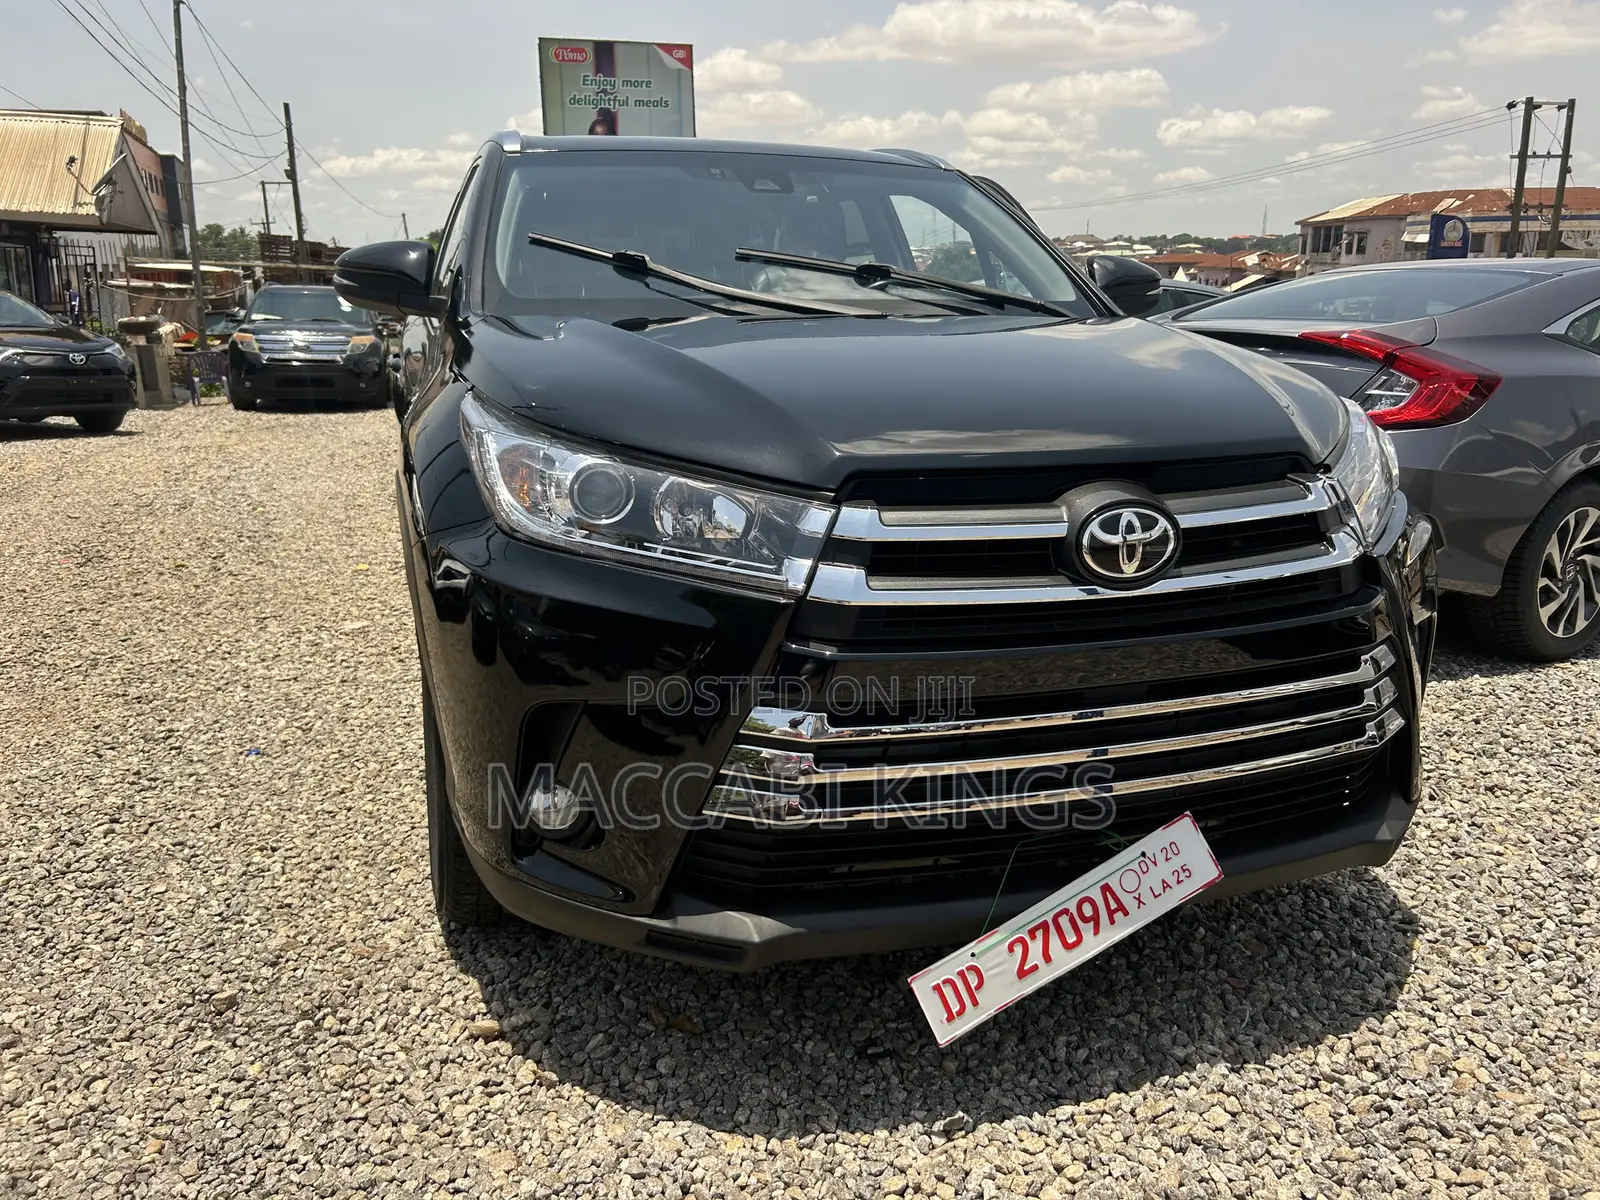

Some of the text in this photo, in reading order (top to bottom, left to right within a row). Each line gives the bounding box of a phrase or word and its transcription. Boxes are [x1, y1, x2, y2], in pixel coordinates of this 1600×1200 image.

[581, 74, 653, 90] Enjoy more
[568, 94, 670, 110] delightful meals
[1138, 841, 1180, 875] DV 20
[1132, 863, 1192, 910] X LA 25
[931, 881, 1130, 1023] DP 2709A
